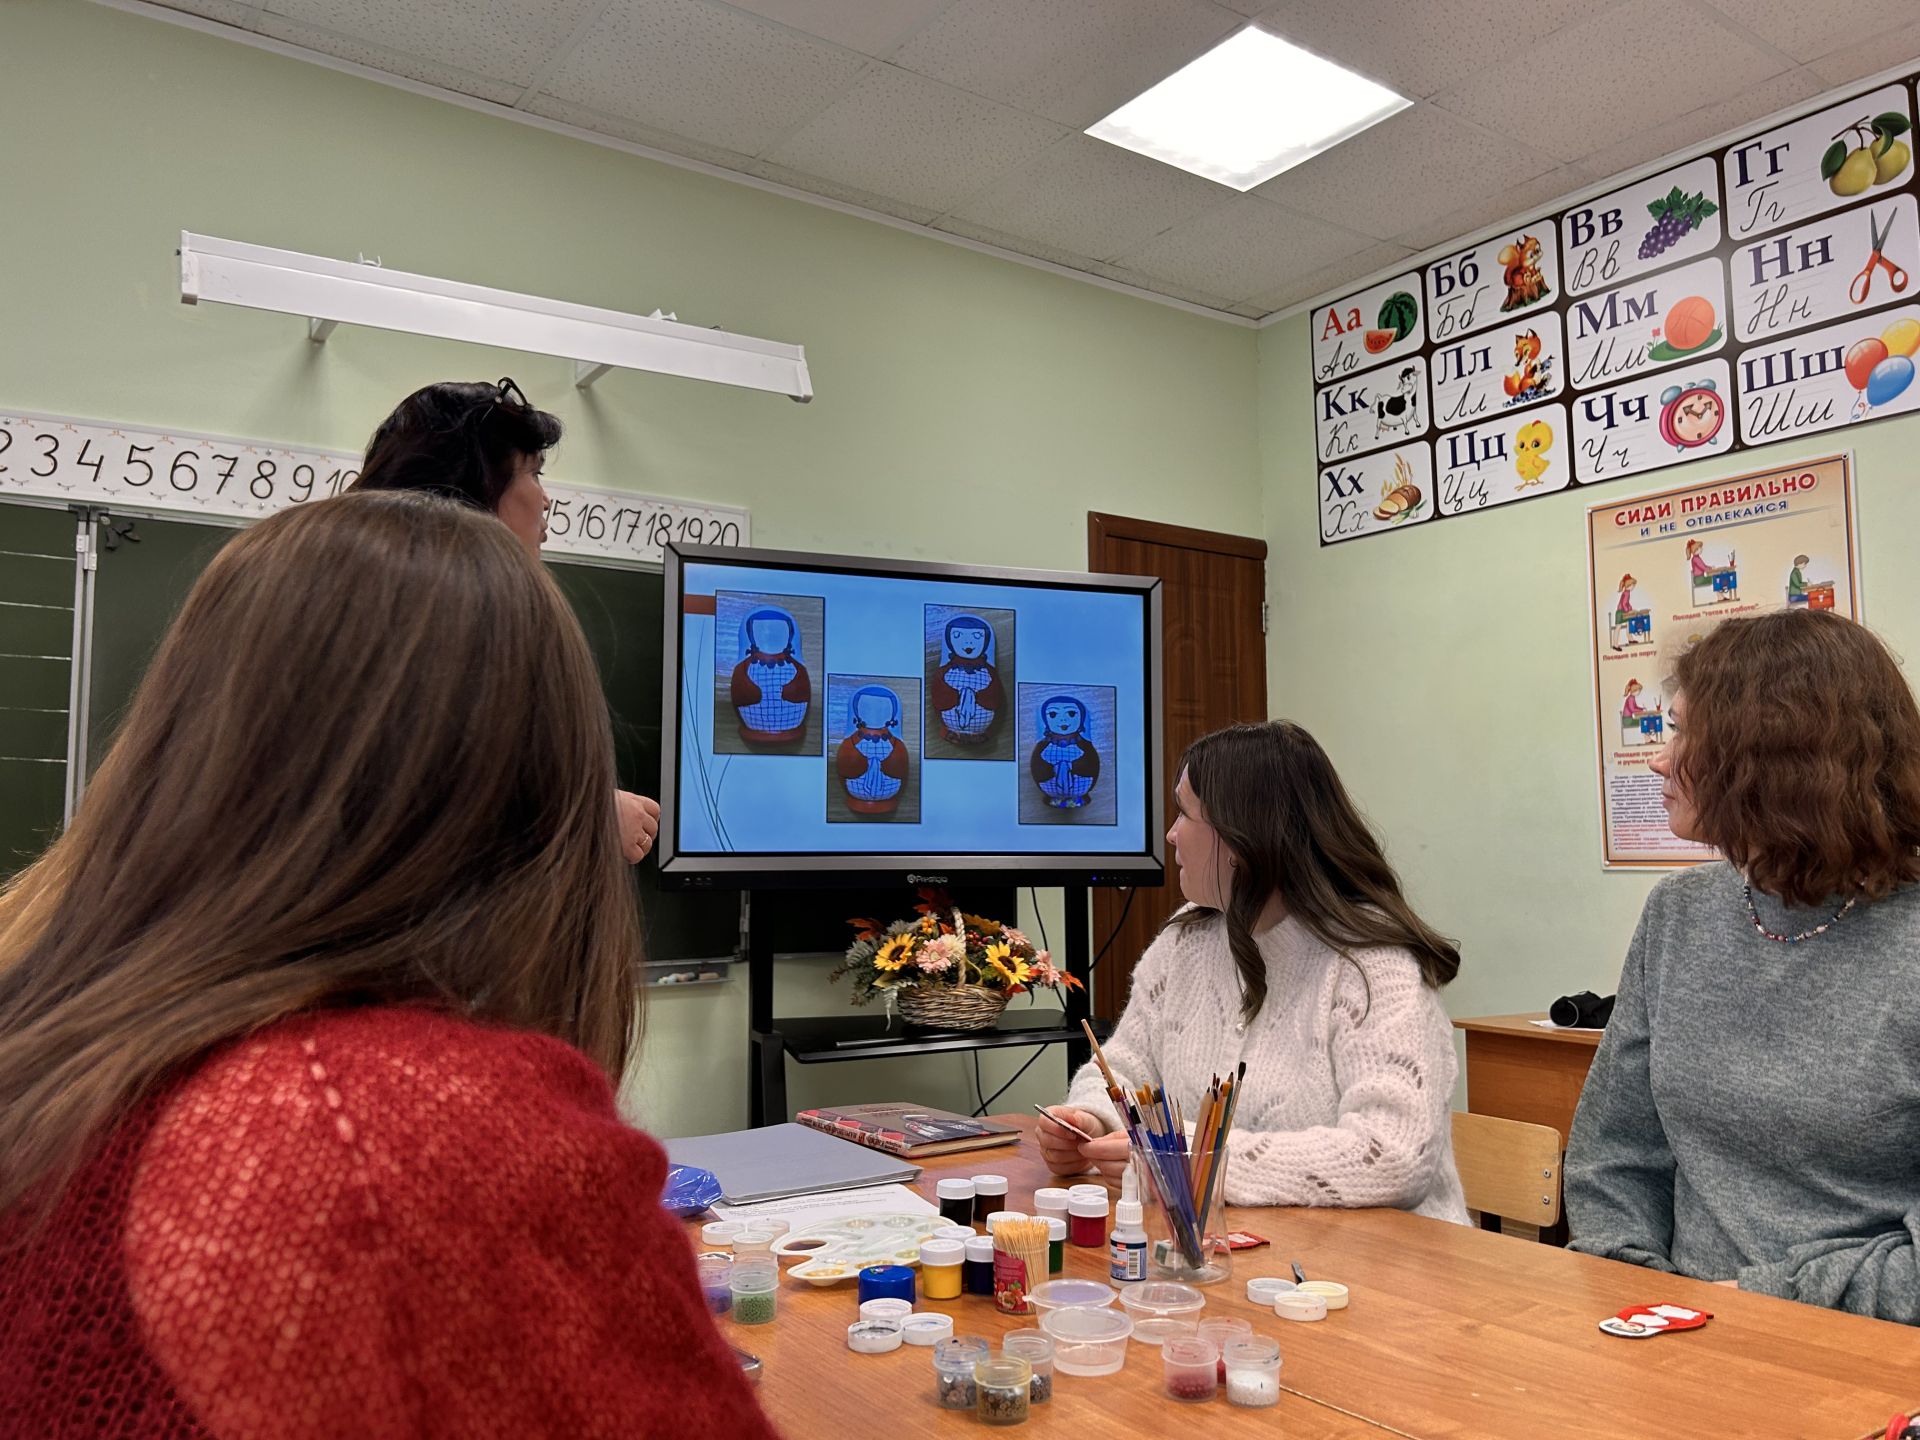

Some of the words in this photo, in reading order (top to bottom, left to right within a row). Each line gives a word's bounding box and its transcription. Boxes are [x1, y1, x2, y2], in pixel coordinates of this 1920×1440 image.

[1733, 141, 1790, 188] Гг
[1566, 207, 1623, 249] Вв
[1431, 251, 1479, 299] Бб
[1748, 235, 1834, 287] Нн
[1321, 305, 1362, 341] Аа
[1575, 291, 1658, 339] Мм
[1438, 345, 1493, 385] Лл
[1741, 345, 1847, 394] Шш
[1322, 385, 1369, 421] Кк
[1581, 392, 1649, 430] Чч
[1447, 430, 1508, 471] Цц
[30, 433, 59, 477] 3
[77, 439, 104, 482] 4
[123, 444, 154, 487] 5
[170, 450, 199, 491] 6
[211, 454, 239, 495] 7
[250, 460, 276, 499] 8
[288, 464, 315, 503] 9
[577, 503, 606, 540] 16
[612, 508, 642, 544] 17
[646, 512, 672, 547] 18
[677, 516, 703, 544] 19
[709, 520, 740, 547] 20
[1325, 467, 1364, 501] Хх
[1614, 502, 1671, 526] СИДИ
[1680, 473, 1816, 513] ПРАВИЛЬНО
[1640, 527, 1649, 536] И
[1659, 521, 1676, 533] НЕ
[1686, 500, 1788, 527] ОТВЛЕКАЙСЯ
